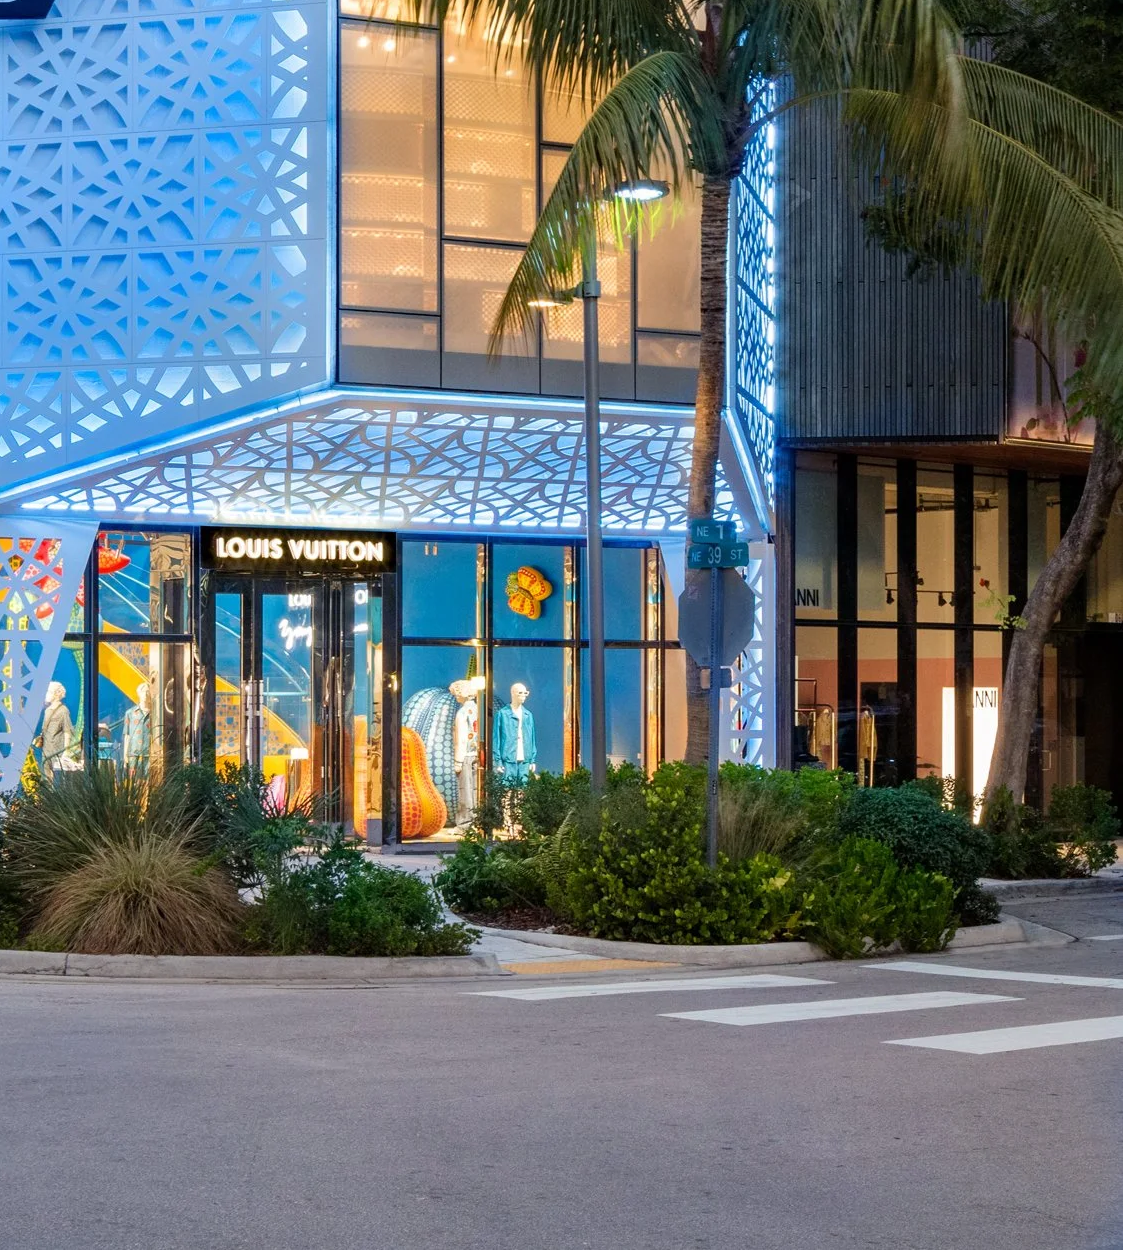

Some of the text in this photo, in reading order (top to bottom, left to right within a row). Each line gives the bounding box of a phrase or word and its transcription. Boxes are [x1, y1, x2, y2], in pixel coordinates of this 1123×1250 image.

[696, 526, 709, 537] NE
[216, 537, 384, 562] LOUIS VUITTON
[691, 546, 743, 564] NE 39 ST
[795, 588, 819, 607] NNI
[974, 690, 997, 708] NNI
